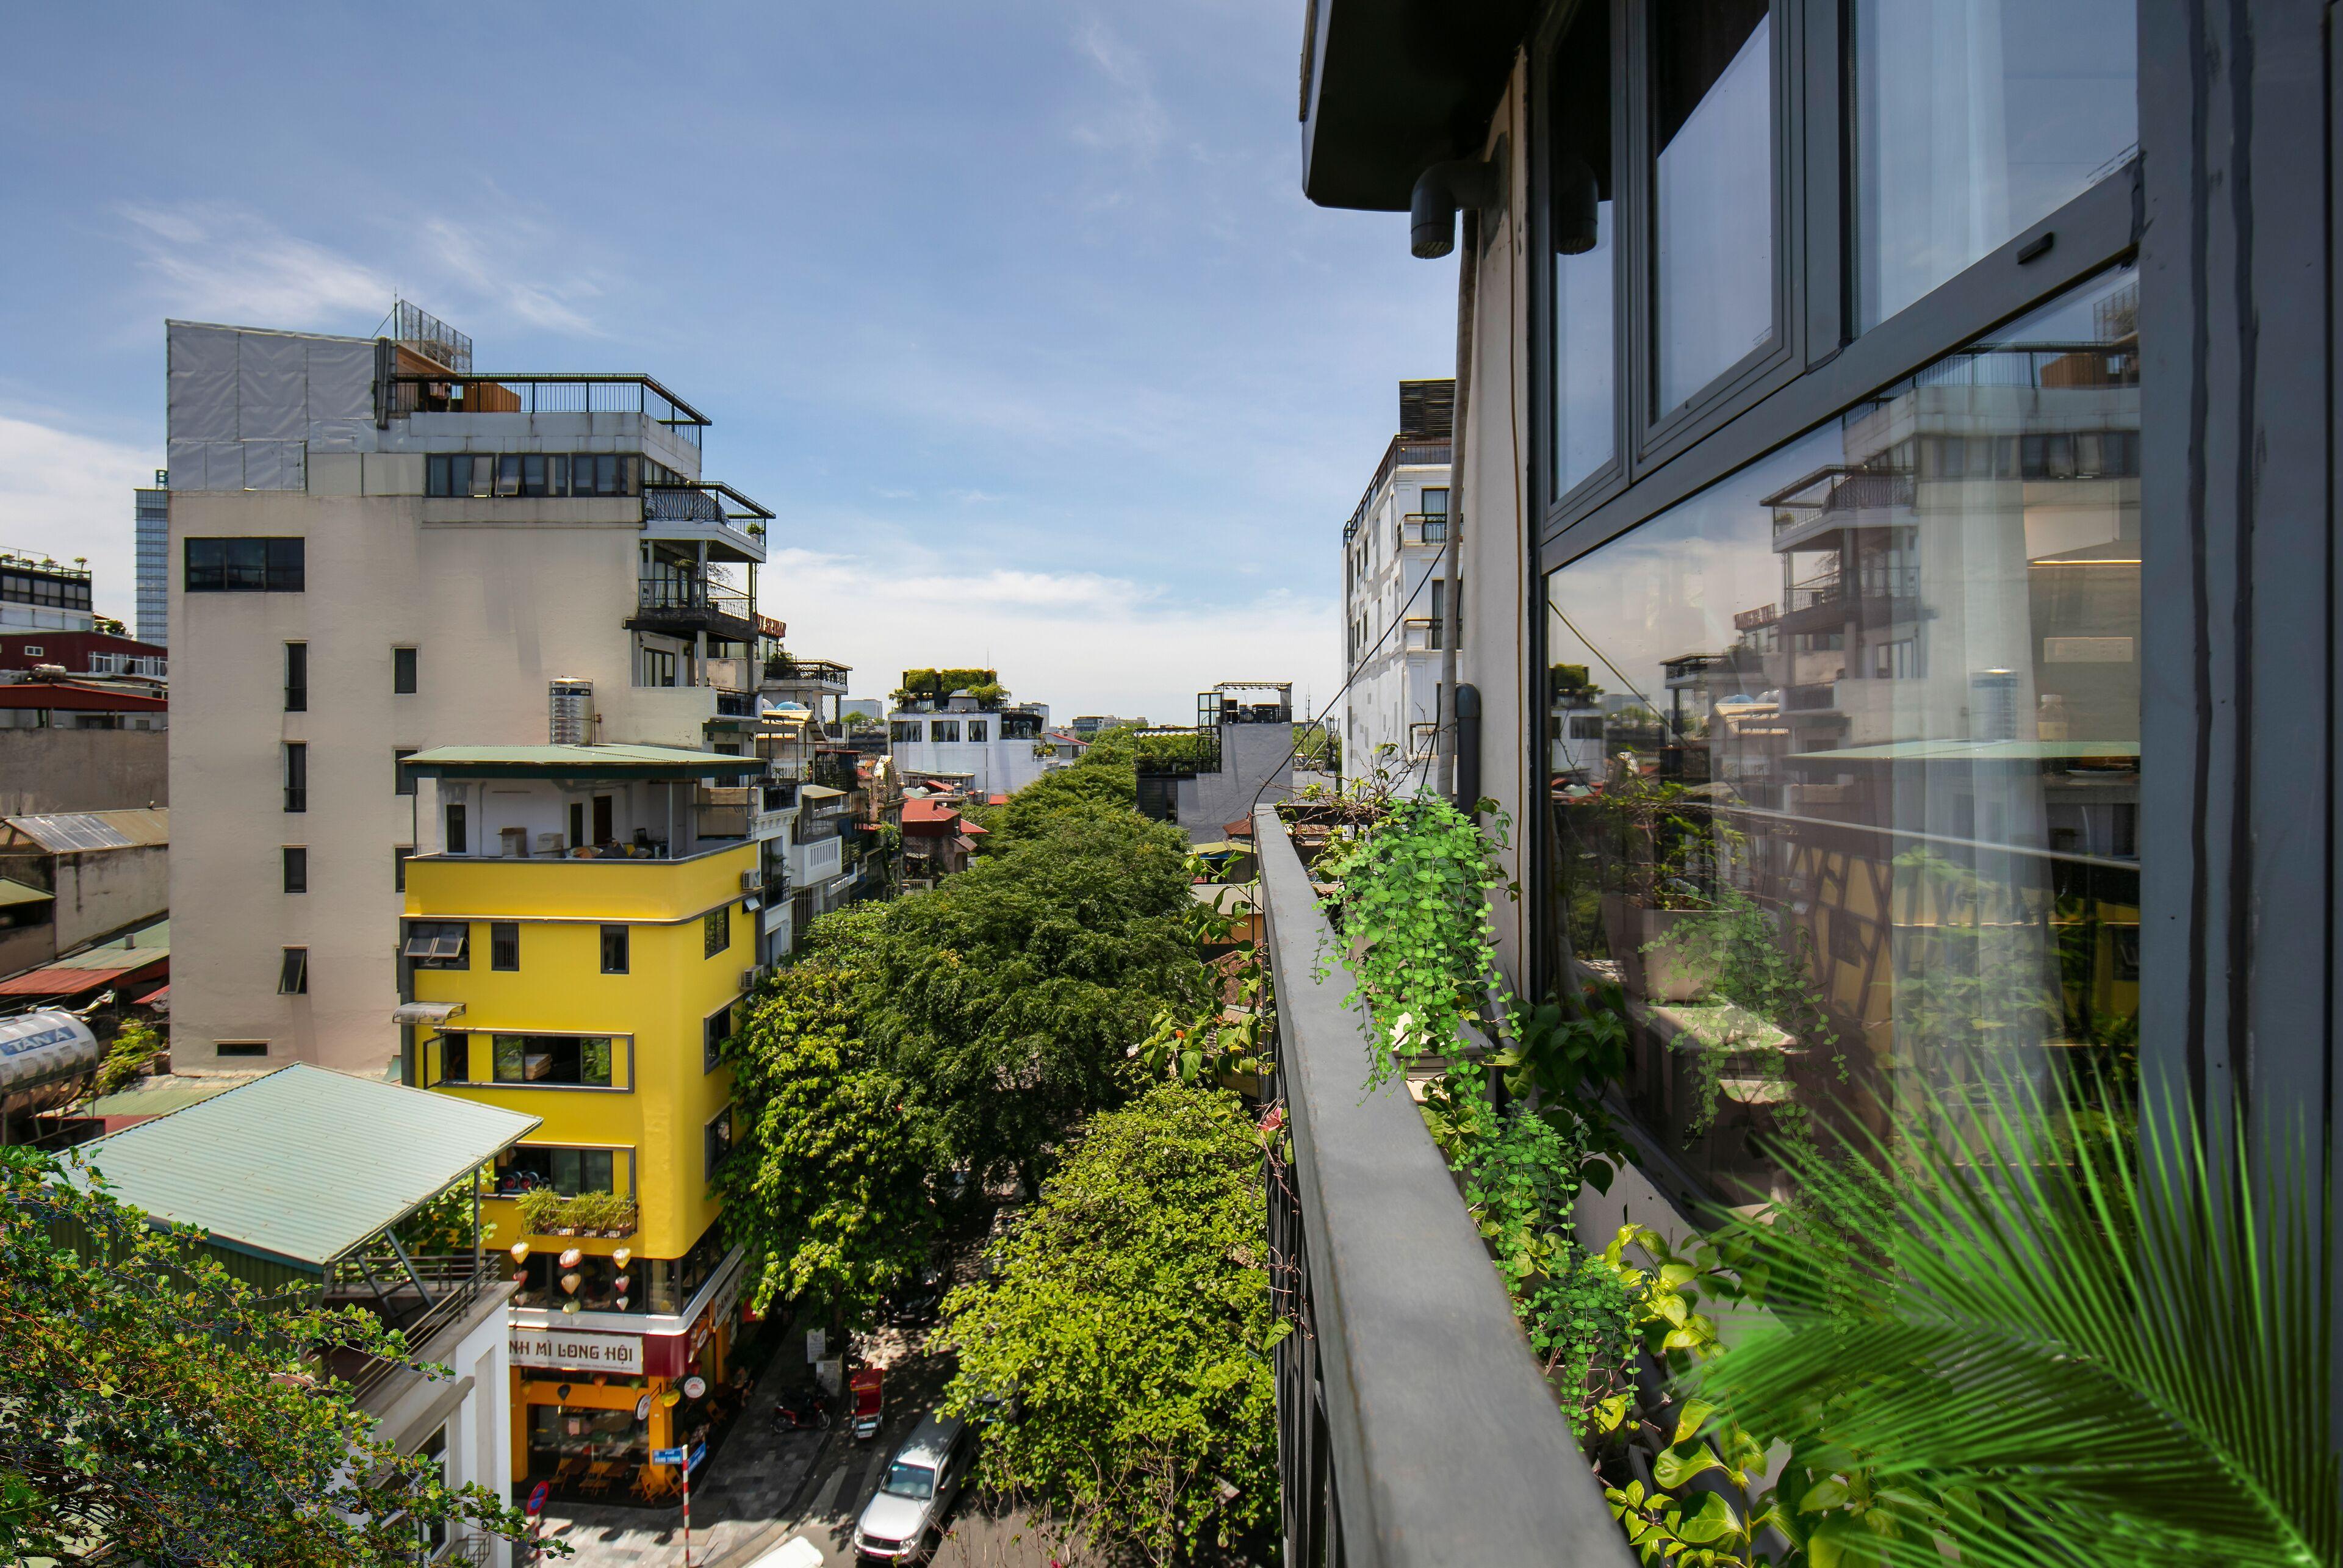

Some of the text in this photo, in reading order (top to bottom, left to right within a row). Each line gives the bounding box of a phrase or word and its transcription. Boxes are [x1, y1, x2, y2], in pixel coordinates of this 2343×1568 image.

[509, 1339, 633, 1364] NH MÌ LONG HỘI
